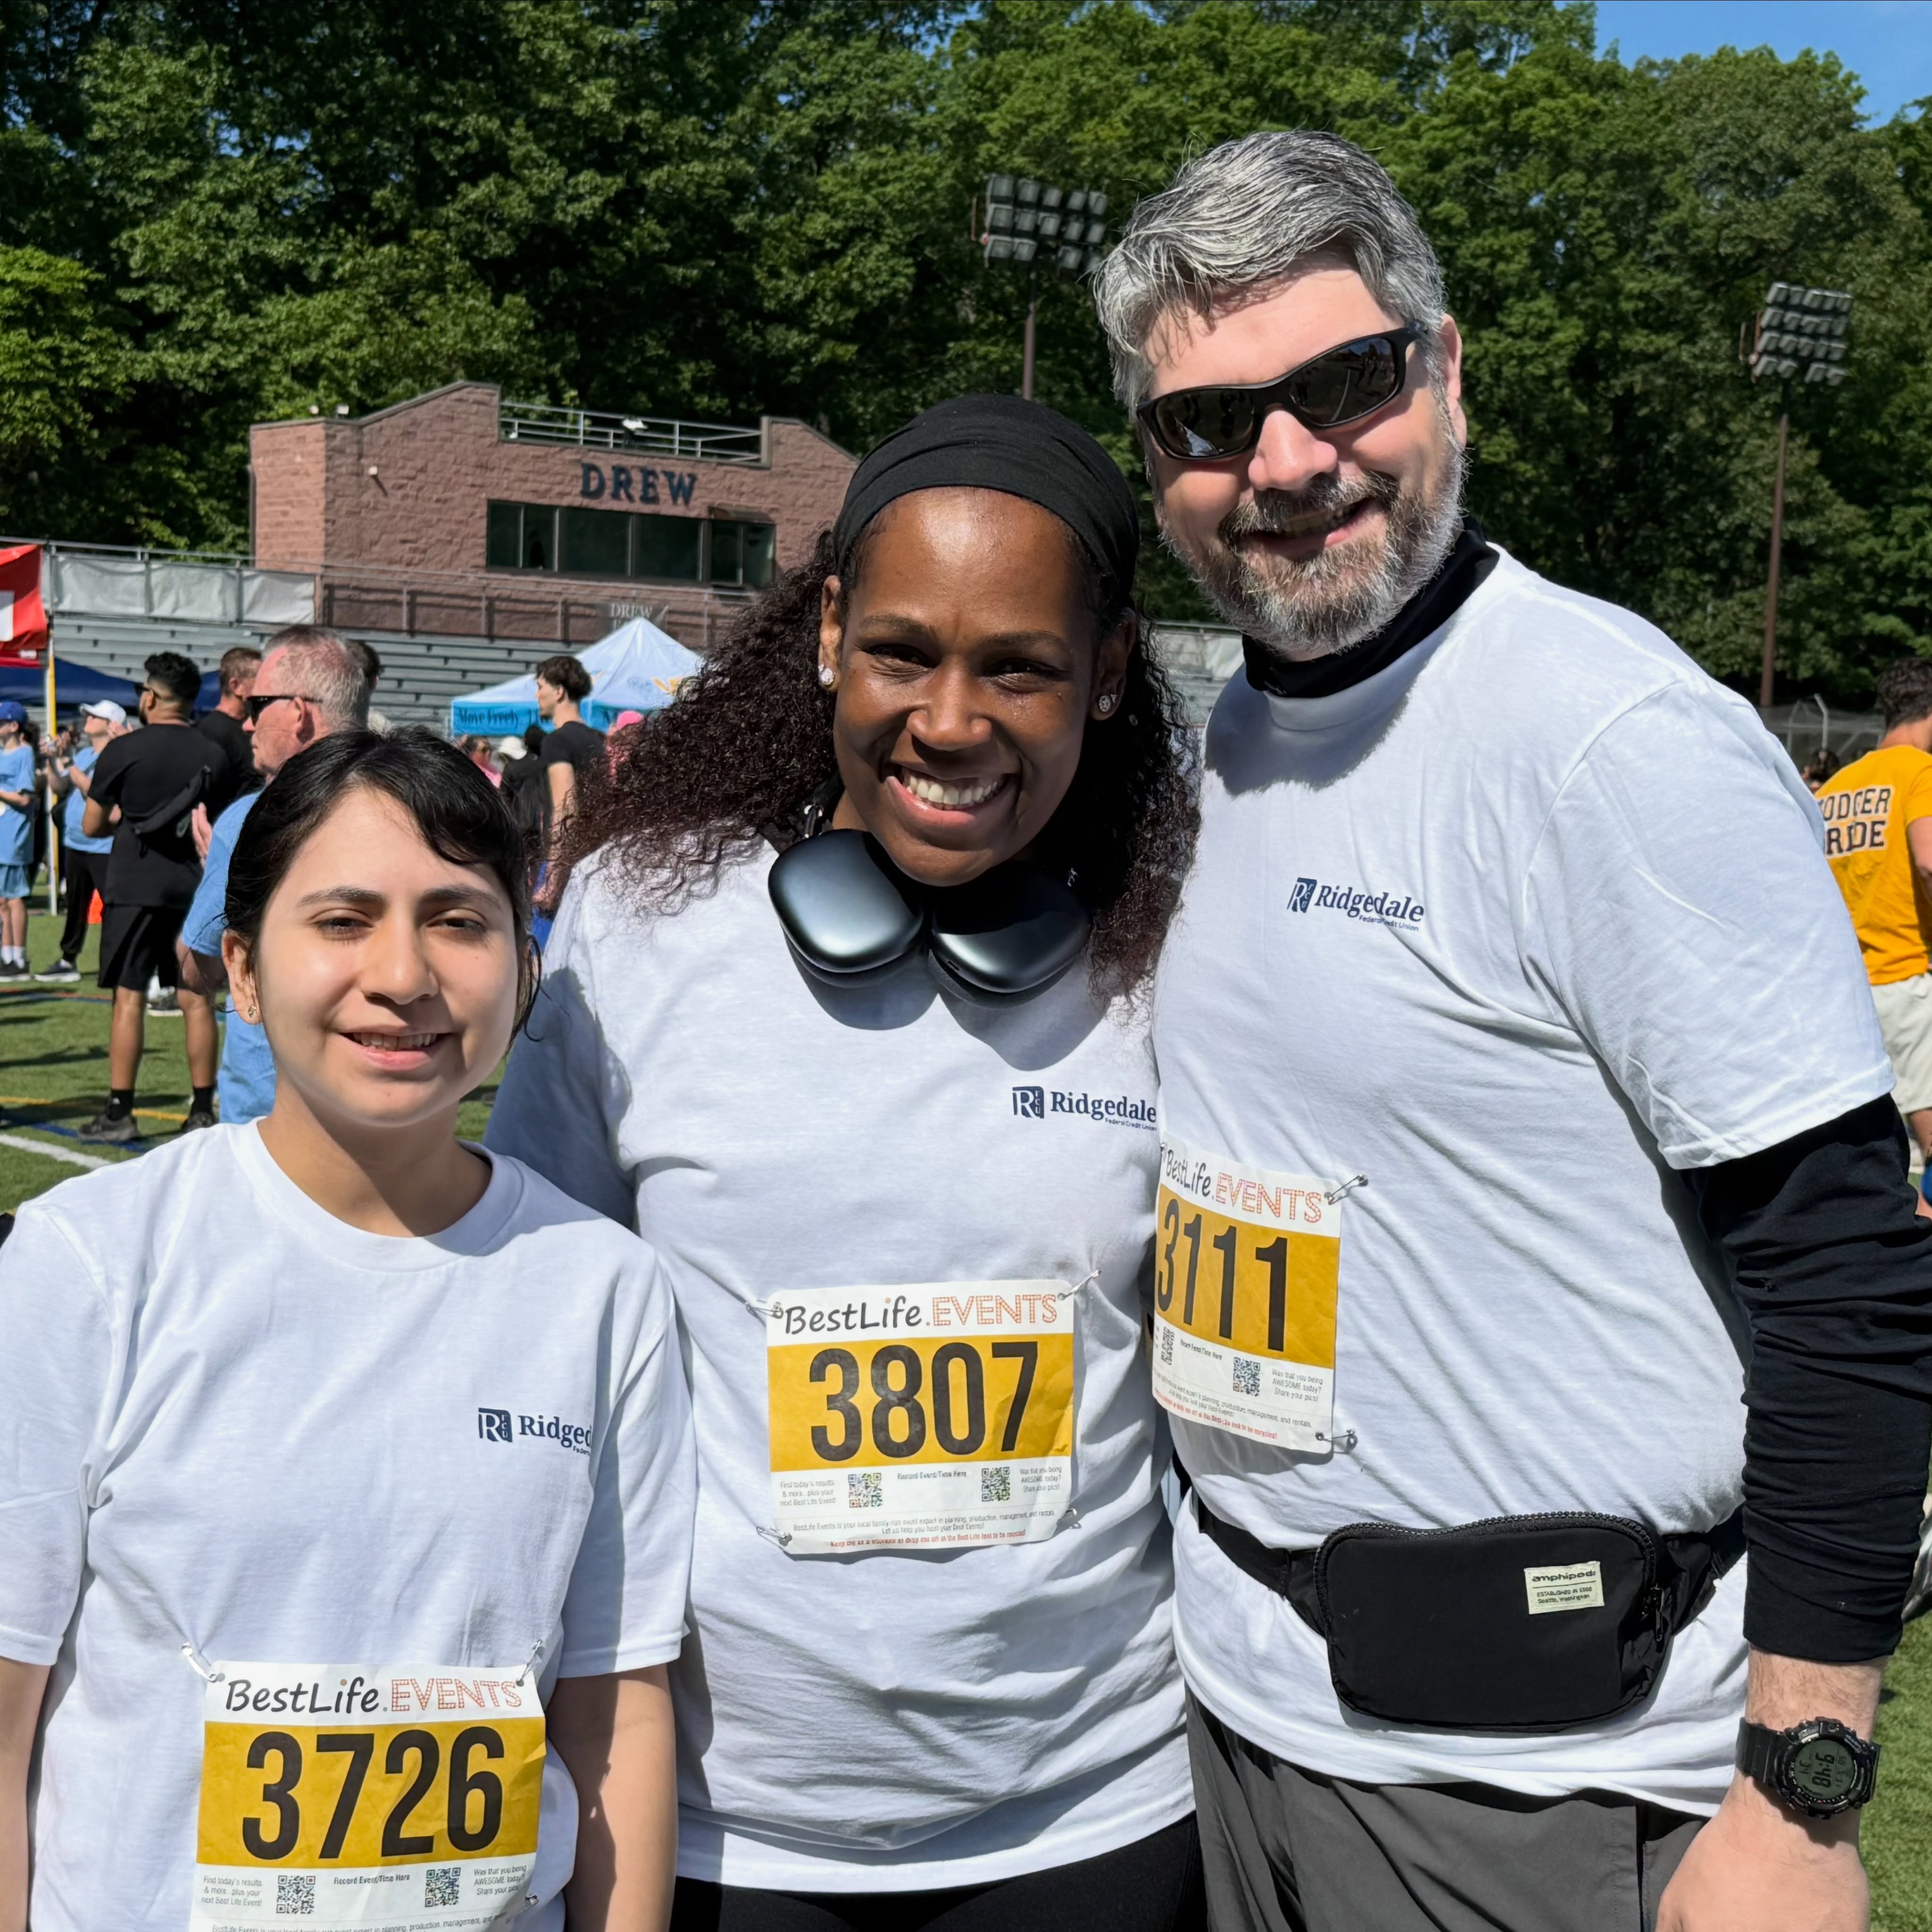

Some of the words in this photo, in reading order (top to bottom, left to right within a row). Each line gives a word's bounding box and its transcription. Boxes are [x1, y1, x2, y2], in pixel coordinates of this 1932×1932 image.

[580, 462, 698, 507] DREW
[1818, 788, 1890, 821] ODGER
[1314, 885, 1424, 922] Ridgedale
[1050, 1091, 1157, 1123] Ridgedale
[1158, 1198, 1288, 1352] 3111
[809, 1341, 1038, 1462] 3807
[242, 1726, 505, 1860] 3726
